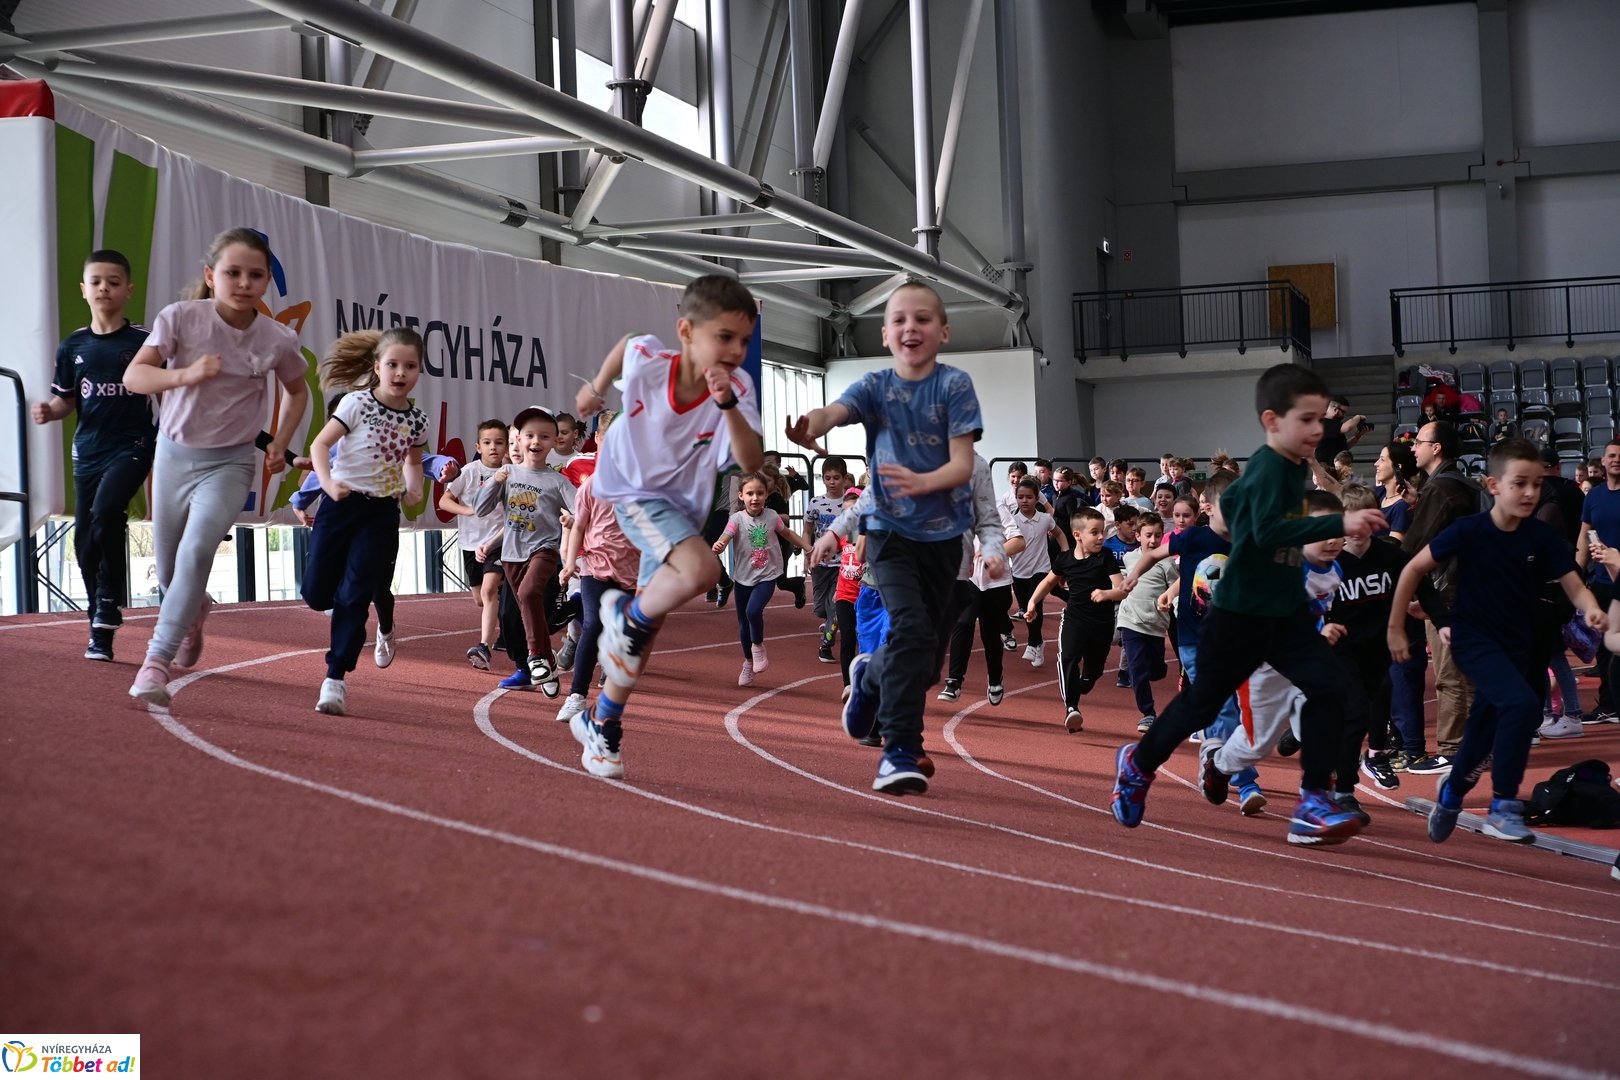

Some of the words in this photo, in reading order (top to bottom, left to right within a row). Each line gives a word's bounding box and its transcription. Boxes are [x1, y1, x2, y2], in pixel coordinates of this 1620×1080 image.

[336, 293, 548, 389] NYÍGYHÁZA
[526, 484, 542, 494] ZONE
[1339, 571, 1392, 601] NASA
